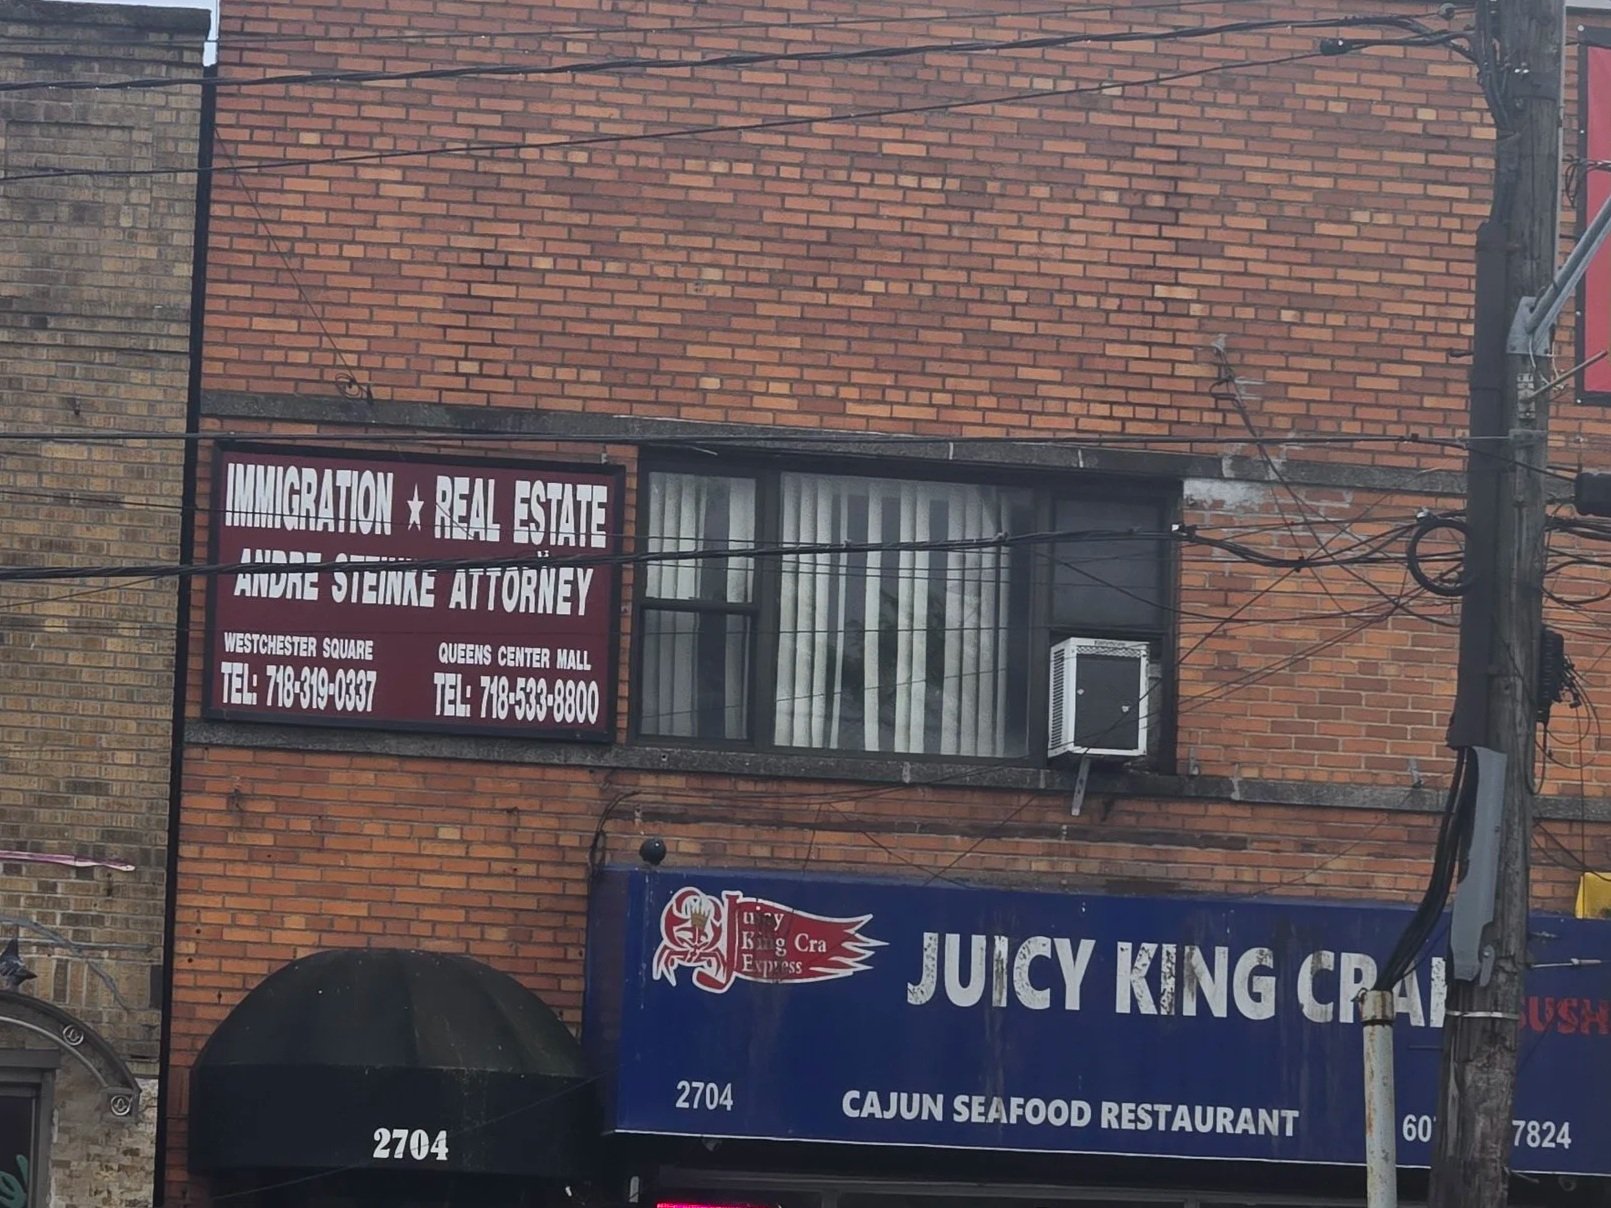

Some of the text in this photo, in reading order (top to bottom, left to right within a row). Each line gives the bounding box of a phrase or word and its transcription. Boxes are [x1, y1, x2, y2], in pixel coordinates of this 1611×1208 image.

[226, 463, 608, 548] IMMIGRATION REAL ESTATE
[233, 548, 594, 616] ANDRE STEINKE ATTORNEY
[224, 632, 374, 661] WESTCHESTER SQUARE
[438, 642, 592, 671] QUEENS CENTER MALL
[221, 661, 377, 712] TEL: 718-319-0337
[434, 672, 600, 725] TEL: 718-533-8800
[794, 932, 827, 953] Cra
[907, 932, 1096, 1010] JUICY
[1115, 941, 1277, 1021] KING
[675, 1080, 734, 1111] 2704
[842, 1089, 1300, 1137] CAJUN SEAFOOD RESTAURANT
[372, 1128, 449, 1161] 2704
[1402, 1114, 1437, 1142] 60
